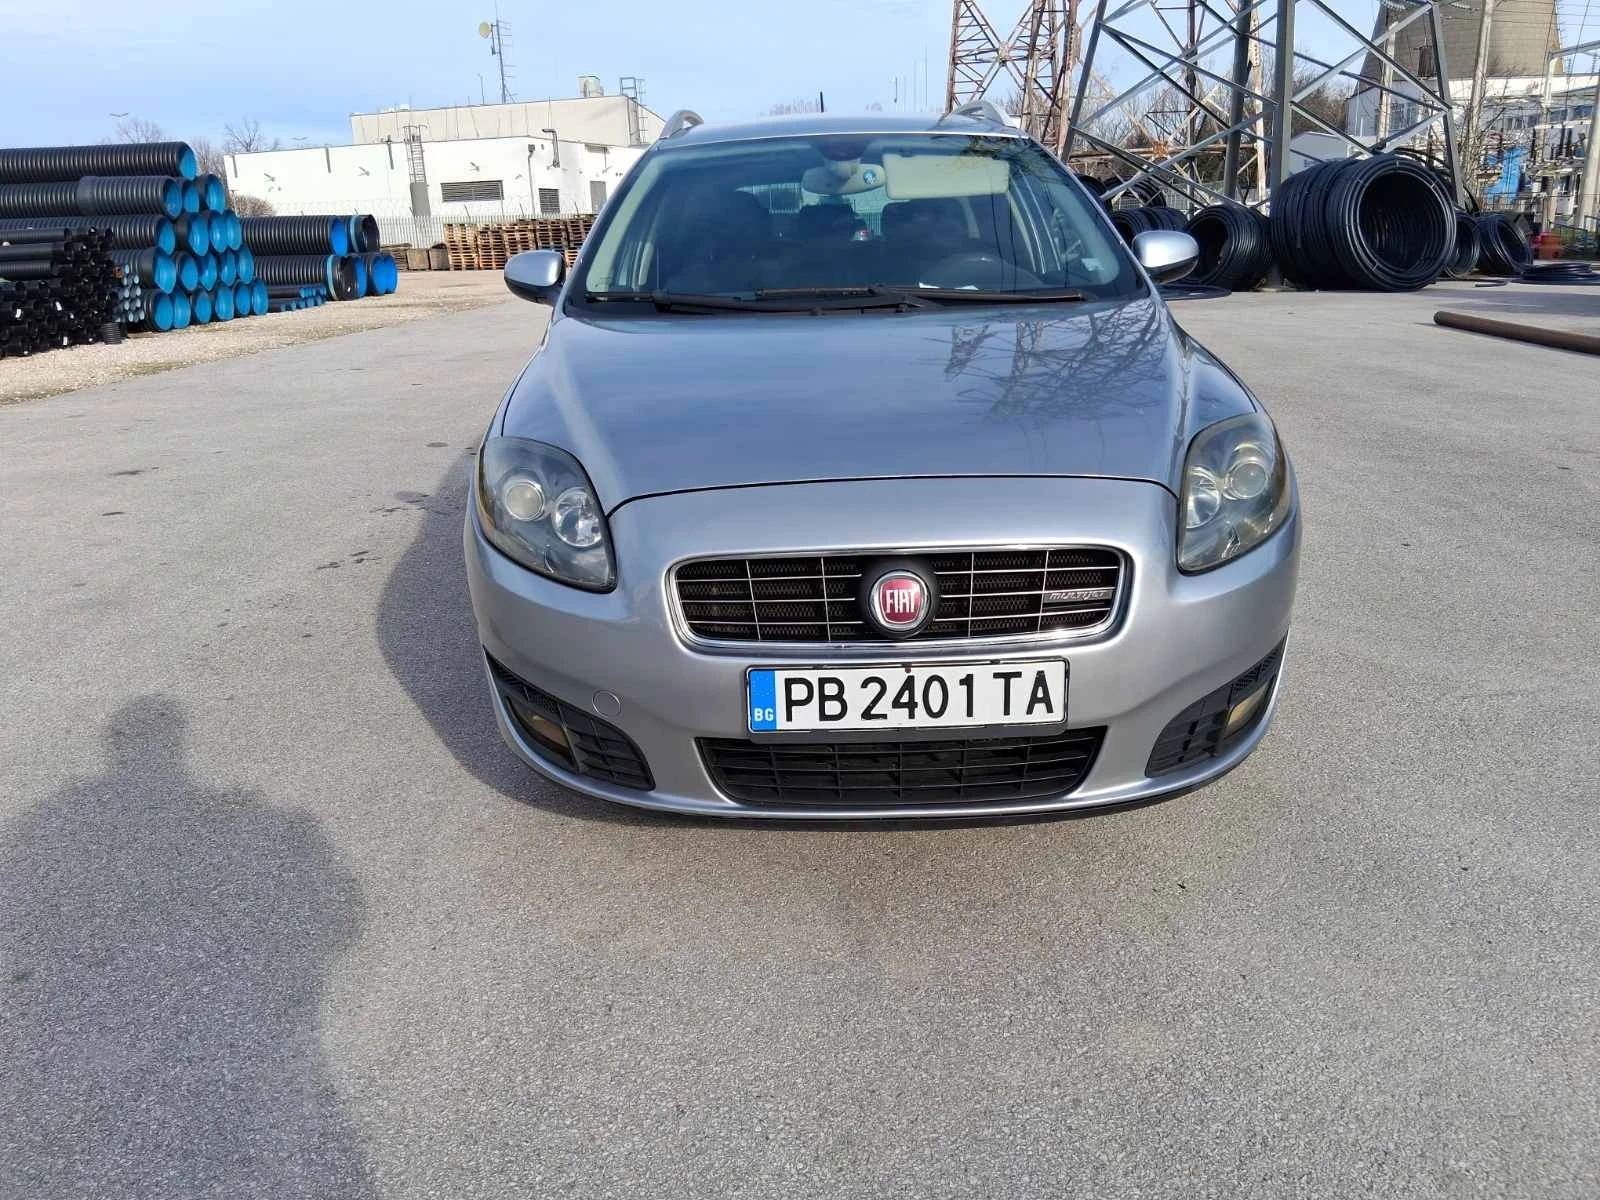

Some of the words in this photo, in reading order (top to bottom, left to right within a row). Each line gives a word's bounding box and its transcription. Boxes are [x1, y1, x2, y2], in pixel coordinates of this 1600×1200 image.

[886, 588, 917, 613] FIAT
[784, 677, 848, 722] PB
[860, 673, 974, 720] 2401
[993, 670, 1054, 716] TA
[754, 708, 774, 721] BG
